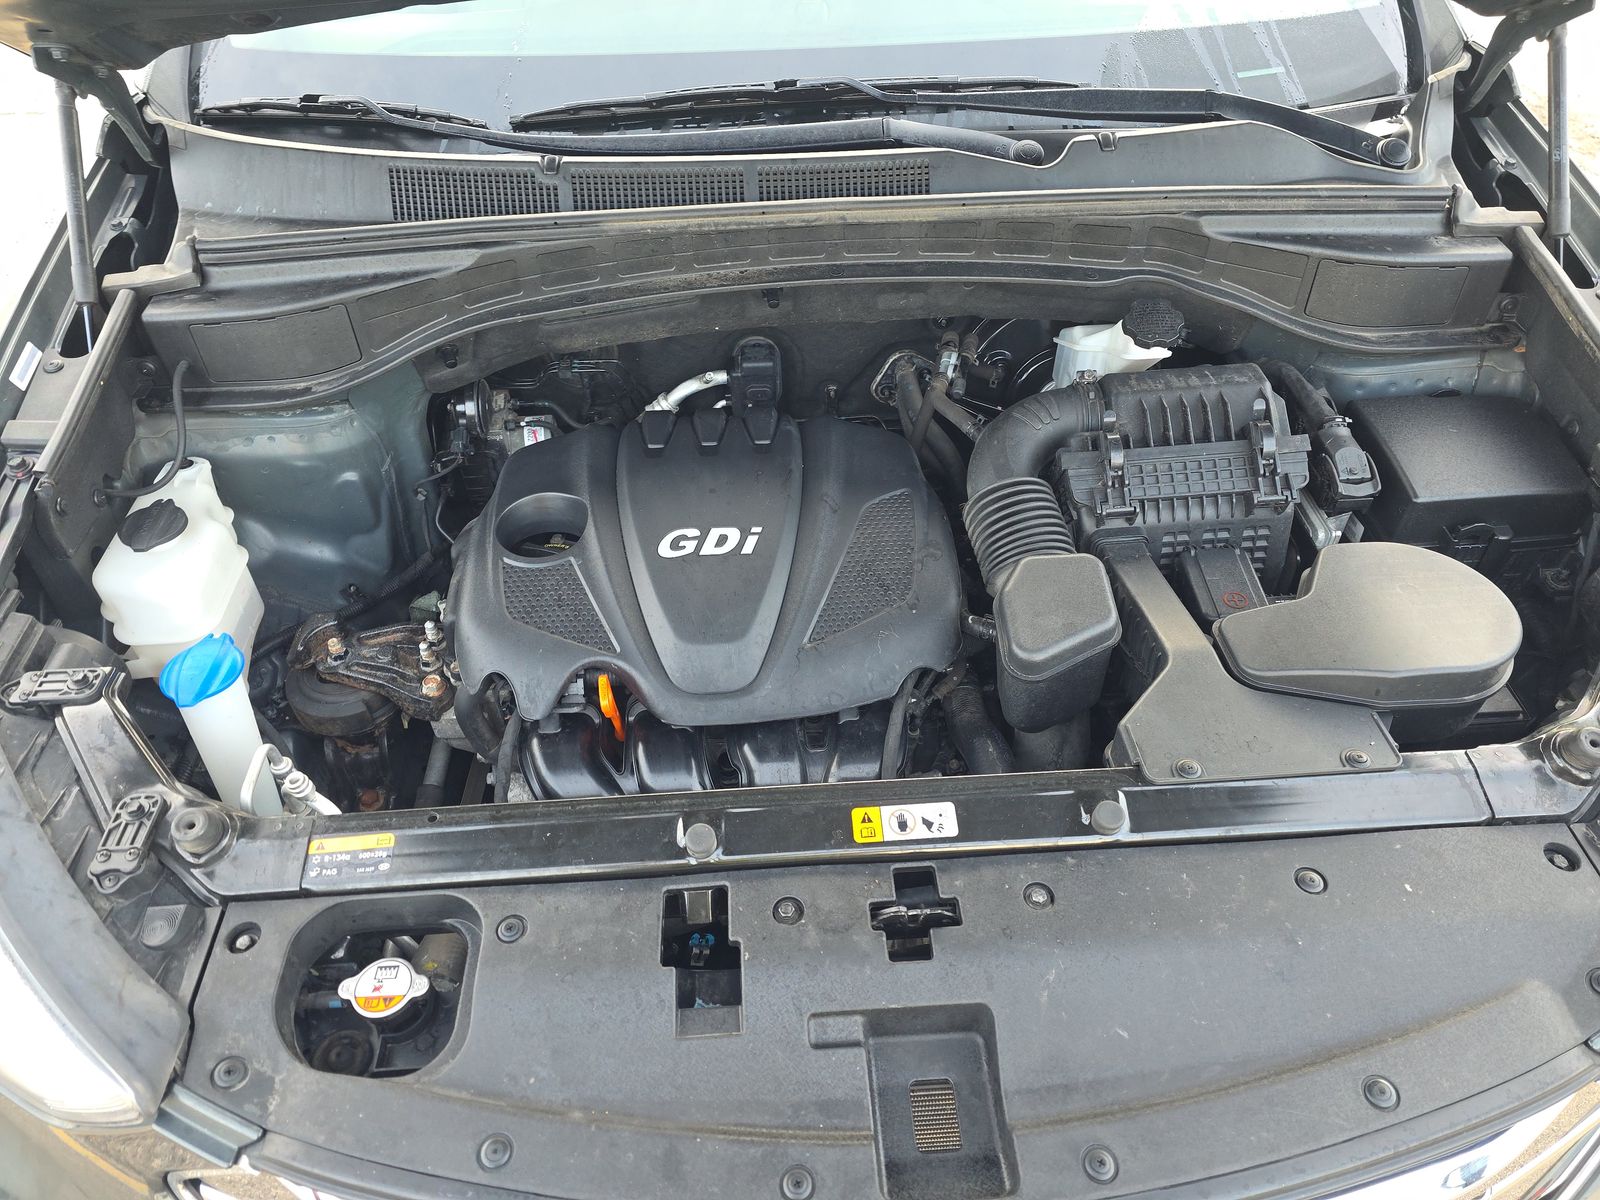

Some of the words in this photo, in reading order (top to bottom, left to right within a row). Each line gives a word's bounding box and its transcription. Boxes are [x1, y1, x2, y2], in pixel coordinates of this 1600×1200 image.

[657, 526, 763, 559] GDi
[323, 853, 351, 862] R-134a
[322, 868, 338, 876] PAG
